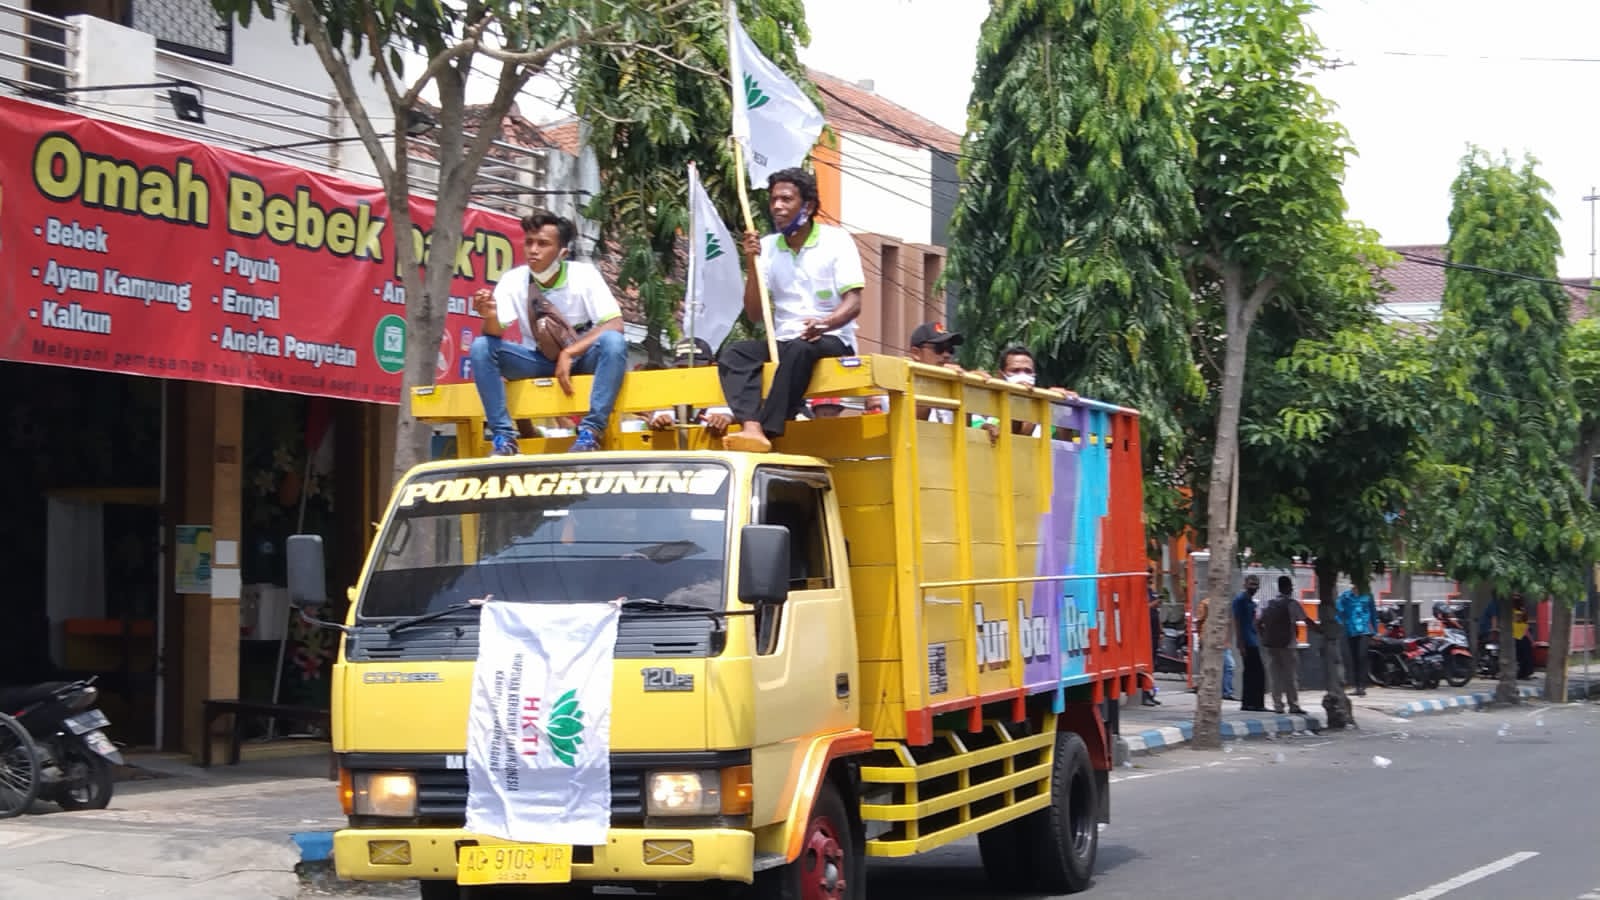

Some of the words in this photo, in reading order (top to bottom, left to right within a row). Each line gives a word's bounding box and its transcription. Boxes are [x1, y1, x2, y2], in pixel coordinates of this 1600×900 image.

[33, 132, 209, 228] Omah
[228, 172, 386, 263] Bebek
[46, 217, 109, 252] Bebek
[224, 249, 280, 284] Puyuh
[43, 259, 99, 294] Ayam
[103, 268, 192, 312] Kampung
[42, 300, 112, 334] Kalkun
[222, 287, 280, 321] Empal
[221, 326, 281, 357] Aneka
[284, 334, 357, 367] Penyetan
[521, 696, 541, 756] HKTI
[496, 849, 535, 870] 9103
